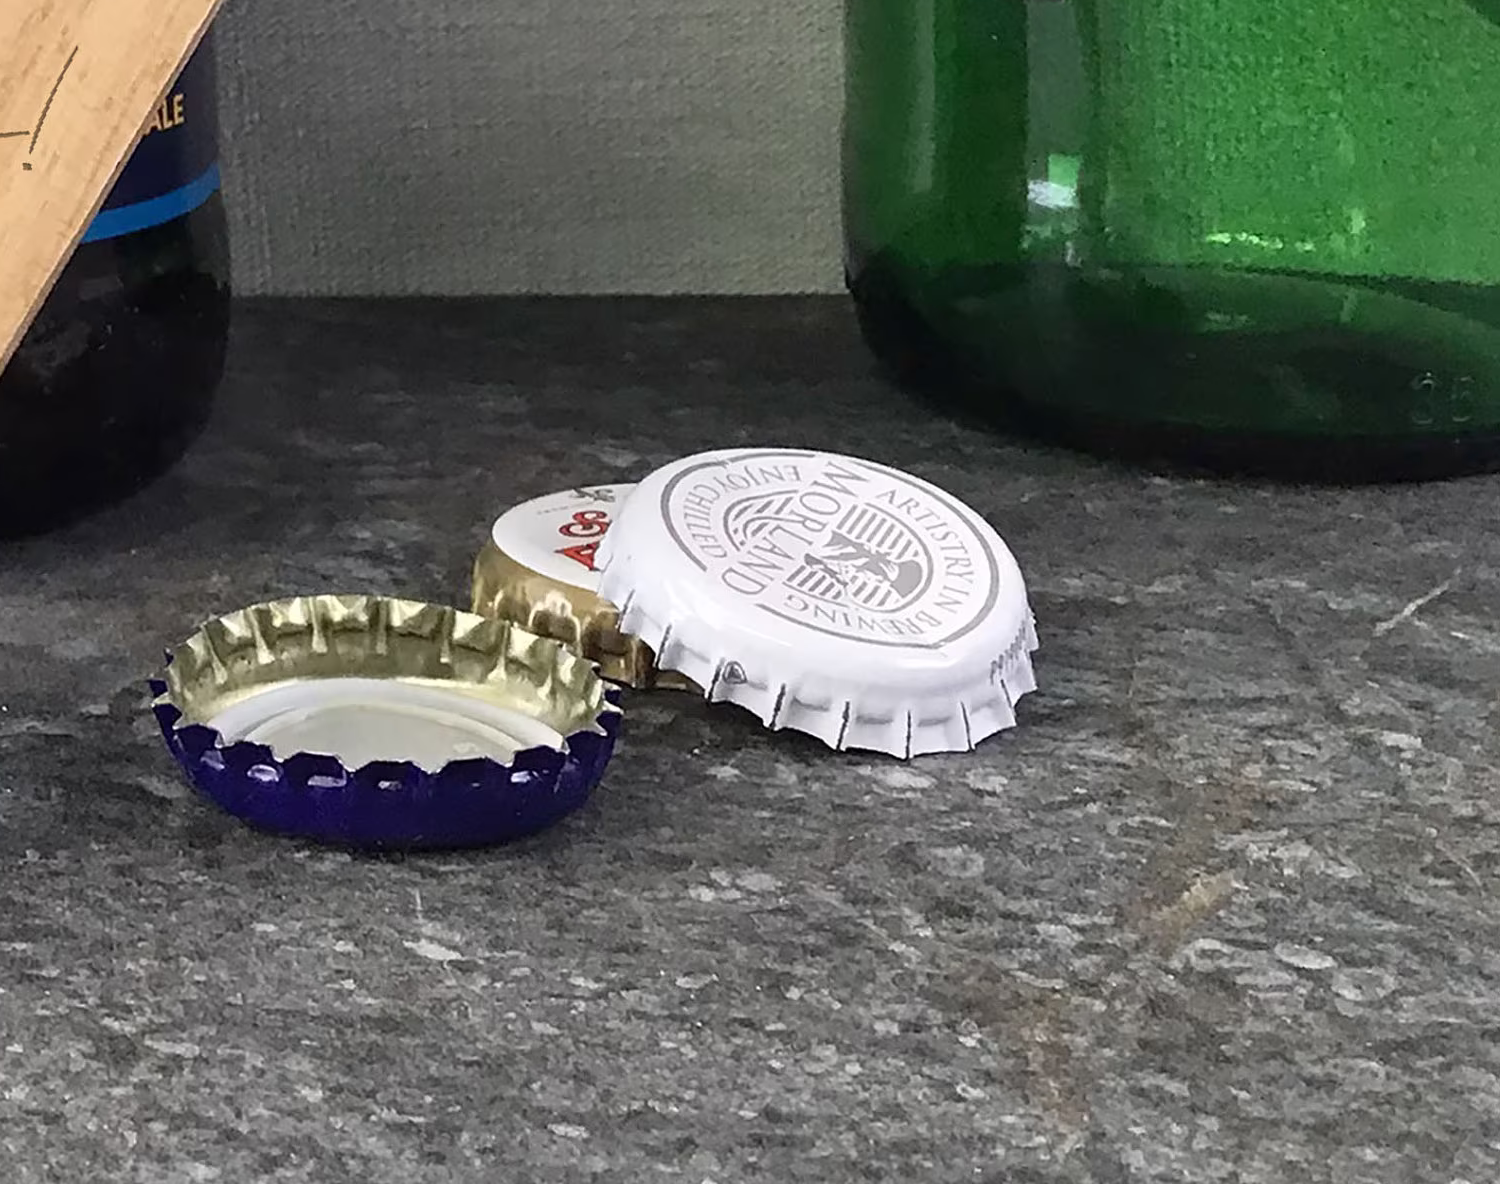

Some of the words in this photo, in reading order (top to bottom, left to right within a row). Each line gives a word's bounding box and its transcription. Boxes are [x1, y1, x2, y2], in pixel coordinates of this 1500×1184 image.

[713, 465, 801, 493] ENJOY
[684, 484, 728, 558] CHILLED
[721, 461, 871, 595] MORLAND
[875, 489, 975, 584] ARTISTRY
[784, 594, 943, 636] BREWING
